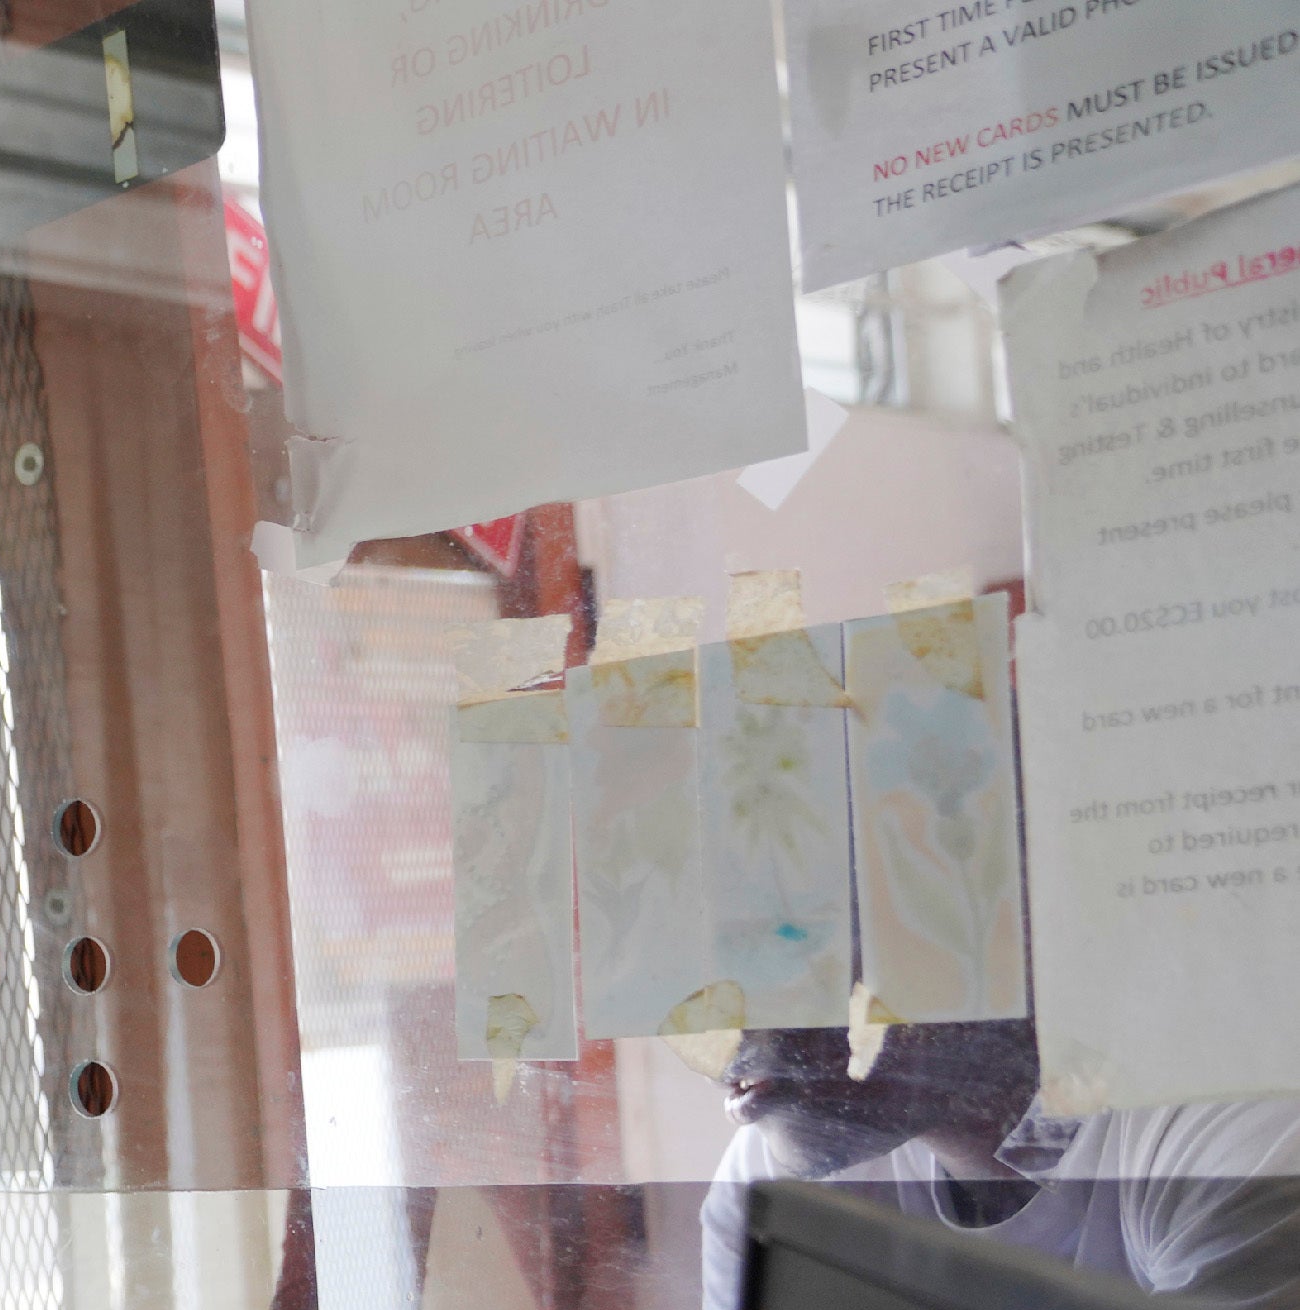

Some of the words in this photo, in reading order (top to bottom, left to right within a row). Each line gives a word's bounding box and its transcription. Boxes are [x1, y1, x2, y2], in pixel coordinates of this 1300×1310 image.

[868, 18, 929, 56] FIRST
[937, 0, 996, 31] TIME
[869, 42, 971, 93] PRESENT
[979, 35, 996, 57] A
[1002, 7, 1076, 46] VALID
[1085, 0, 1137, 20] PH
[873, 155, 908, 182] NO
[916, 135, 970, 169] NEW
[977, 107, 1060, 147] CARDS
[1067, 80, 1146, 121] MUST
[1154, 66, 1187, 95] BE
[1196, 30, 1299, 82] ISSUED
[873, 188, 916, 217] THE
[923, 156, 1015, 203] RECEIPT
[1022, 149, 1043, 171] IS
[1052, 102, 1213, 164] PRESENTED.
